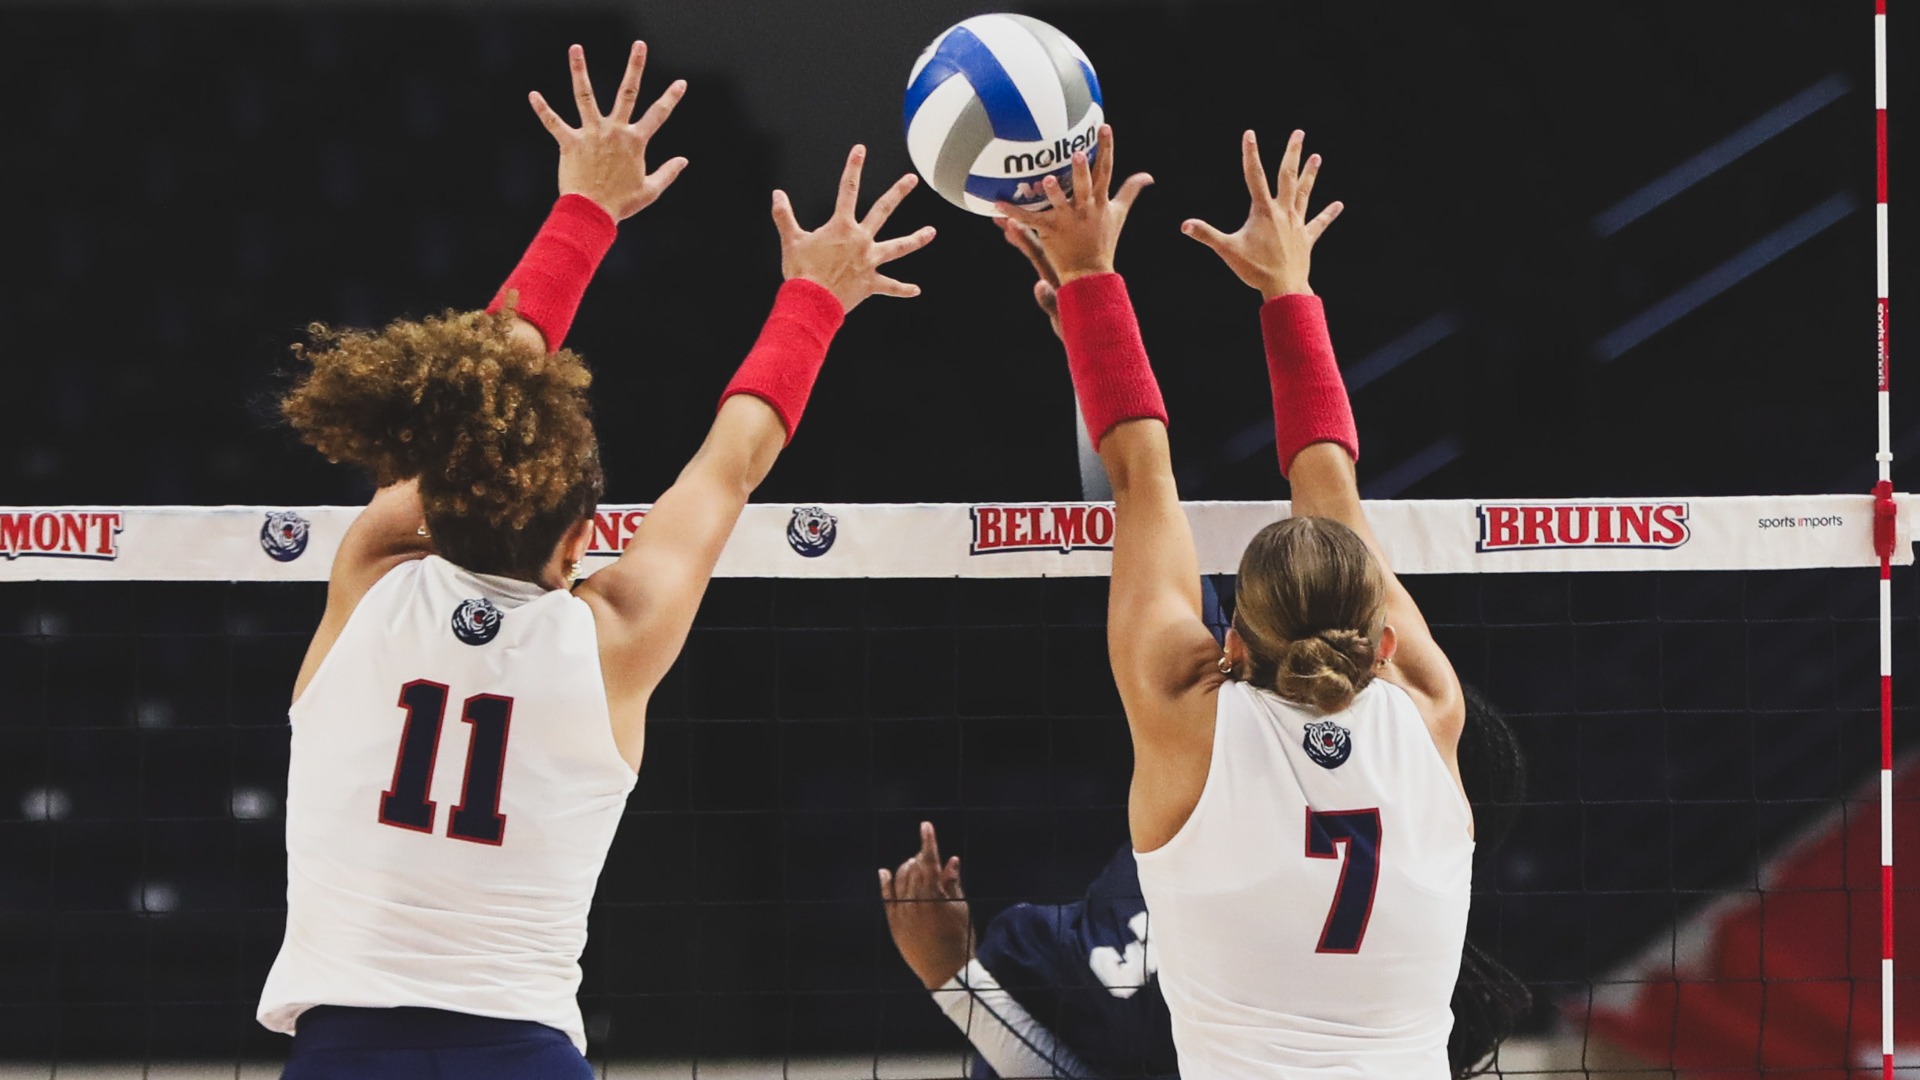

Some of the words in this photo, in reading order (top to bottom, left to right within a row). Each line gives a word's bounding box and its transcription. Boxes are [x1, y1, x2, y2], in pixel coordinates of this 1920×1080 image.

[1004, 126, 1096, 173] molten
[972, 505, 1117, 553] BELMO
[1479, 503, 1688, 550] BRUINS
[1758, 516, 1795, 530] sports
[1798, 515, 1843, 529] imports
[378, 678, 514, 847] 11
[1305, 806, 1382, 954] 7
